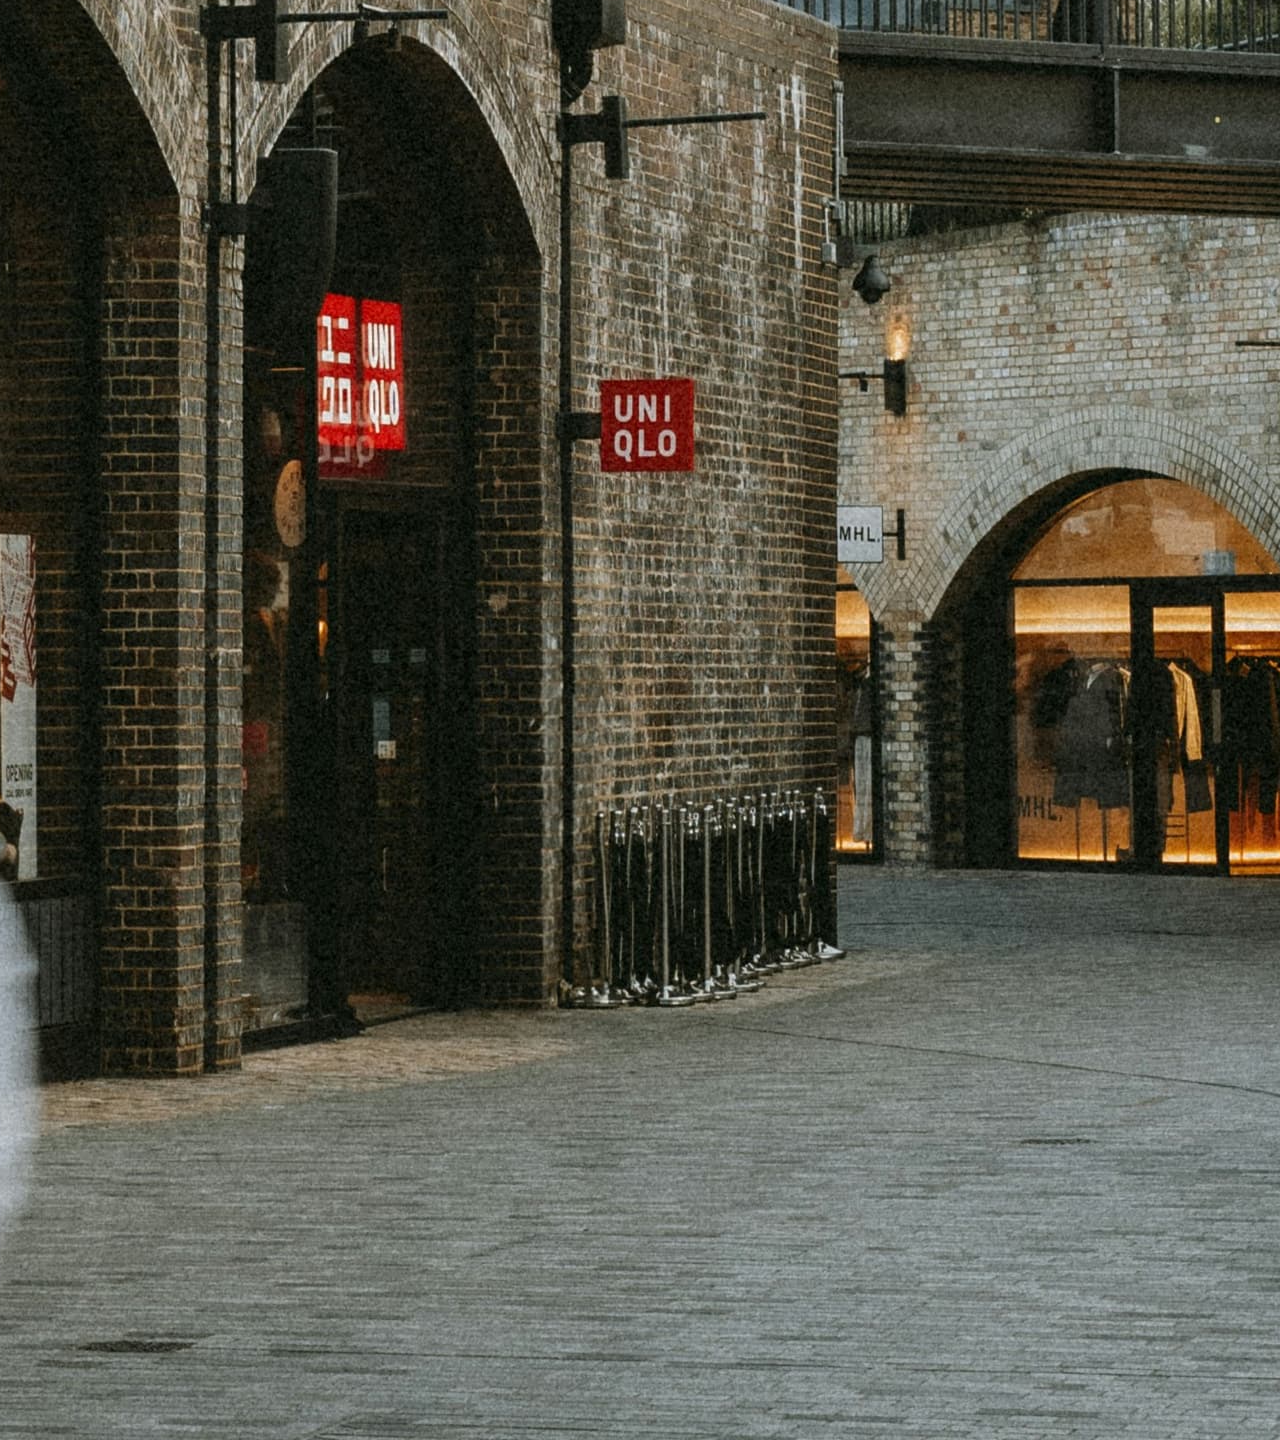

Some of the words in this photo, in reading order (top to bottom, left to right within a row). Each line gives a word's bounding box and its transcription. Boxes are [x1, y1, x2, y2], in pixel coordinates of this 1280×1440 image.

[366, 323, 395, 370] UNI
[368, 380, 400, 433] QLO
[614, 394, 671, 423] UNI
[614, 429, 677, 462] QLO
[839, 525, 881, 543] MHL.
